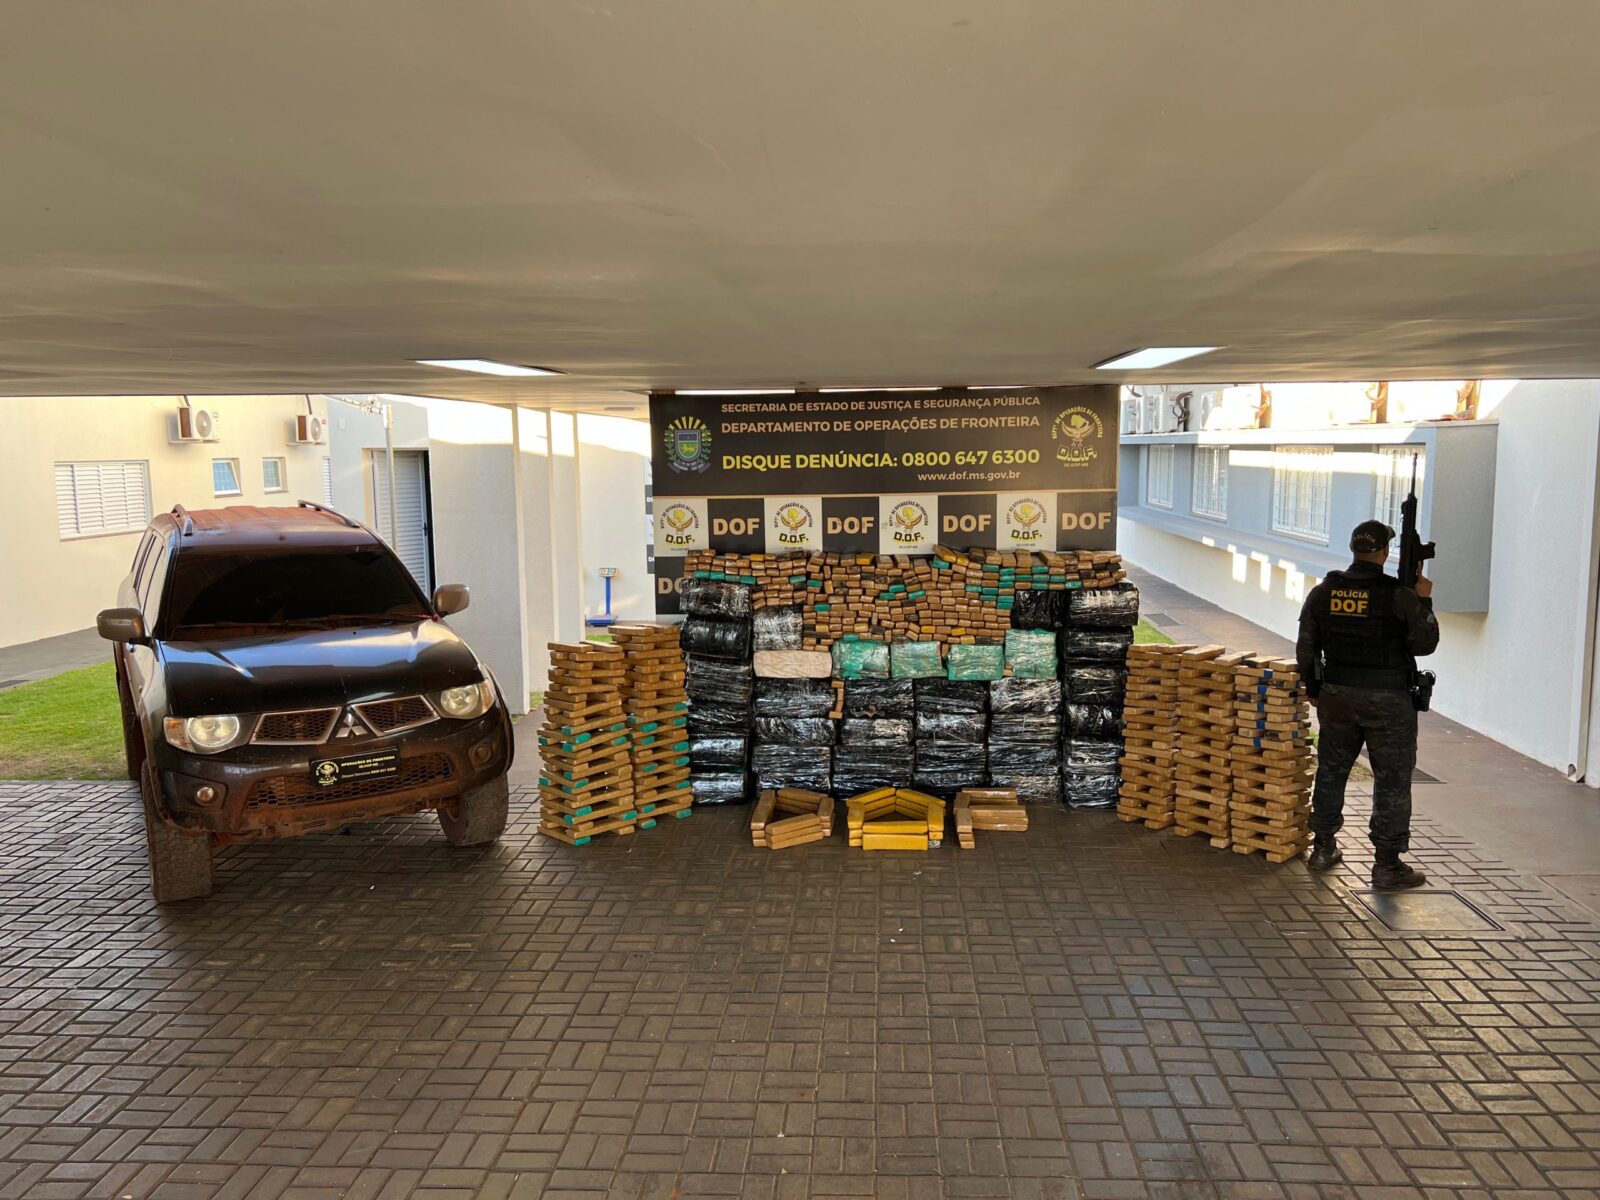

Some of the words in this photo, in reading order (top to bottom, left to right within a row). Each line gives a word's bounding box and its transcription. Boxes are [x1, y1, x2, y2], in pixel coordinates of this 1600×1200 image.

[721, 403, 787, 413] SECRETARIA
[789, 402, 803, 412] DE
[806, 402, 848, 411] ESTADO
[851, 401, 865, 410] DE
[867, 400, 911, 411] JUSTIÇA
[914, 400, 921, 409] E
[923, 398, 991, 409] SEGURANÇA
[993, 395, 1040, 407] PÚBLICA
[721, 421, 830, 433] DEPARTAMENTO
[833, 421, 851, 432] DE
[854, 416, 937, 432] OPERAÇÕES
[940, 418, 958, 429] DE
[961, 416, 1040, 428] FRONTEIRA
[722, 454, 791, 472] DISQUE
[795, 450, 897, 469] DENÚNCIA:
[901, 451, 951, 467] 0800
[954, 450, 988, 465] 647
[991, 449, 1040, 464] 6300
[1056, 445, 1097, 461] D.O.F.
[917, 470, 1021, 481] www.dof.ms.gov.br
[713, 517, 760, 535] DOF
[827, 516, 874, 534] DOF
[943, 514, 991, 532] DOF
[1062, 512, 1111, 530] DOF
[665, 533, 695, 544] D.O.F.
[779, 533, 809, 543] D.O.F.
[893, 531, 924, 542] D.O.F.
[1011, 529, 1042, 540] D.O.F.
[1331, 589, 1368, 598] POLÍCIA
[1330, 598, 1368, 613] DOF
